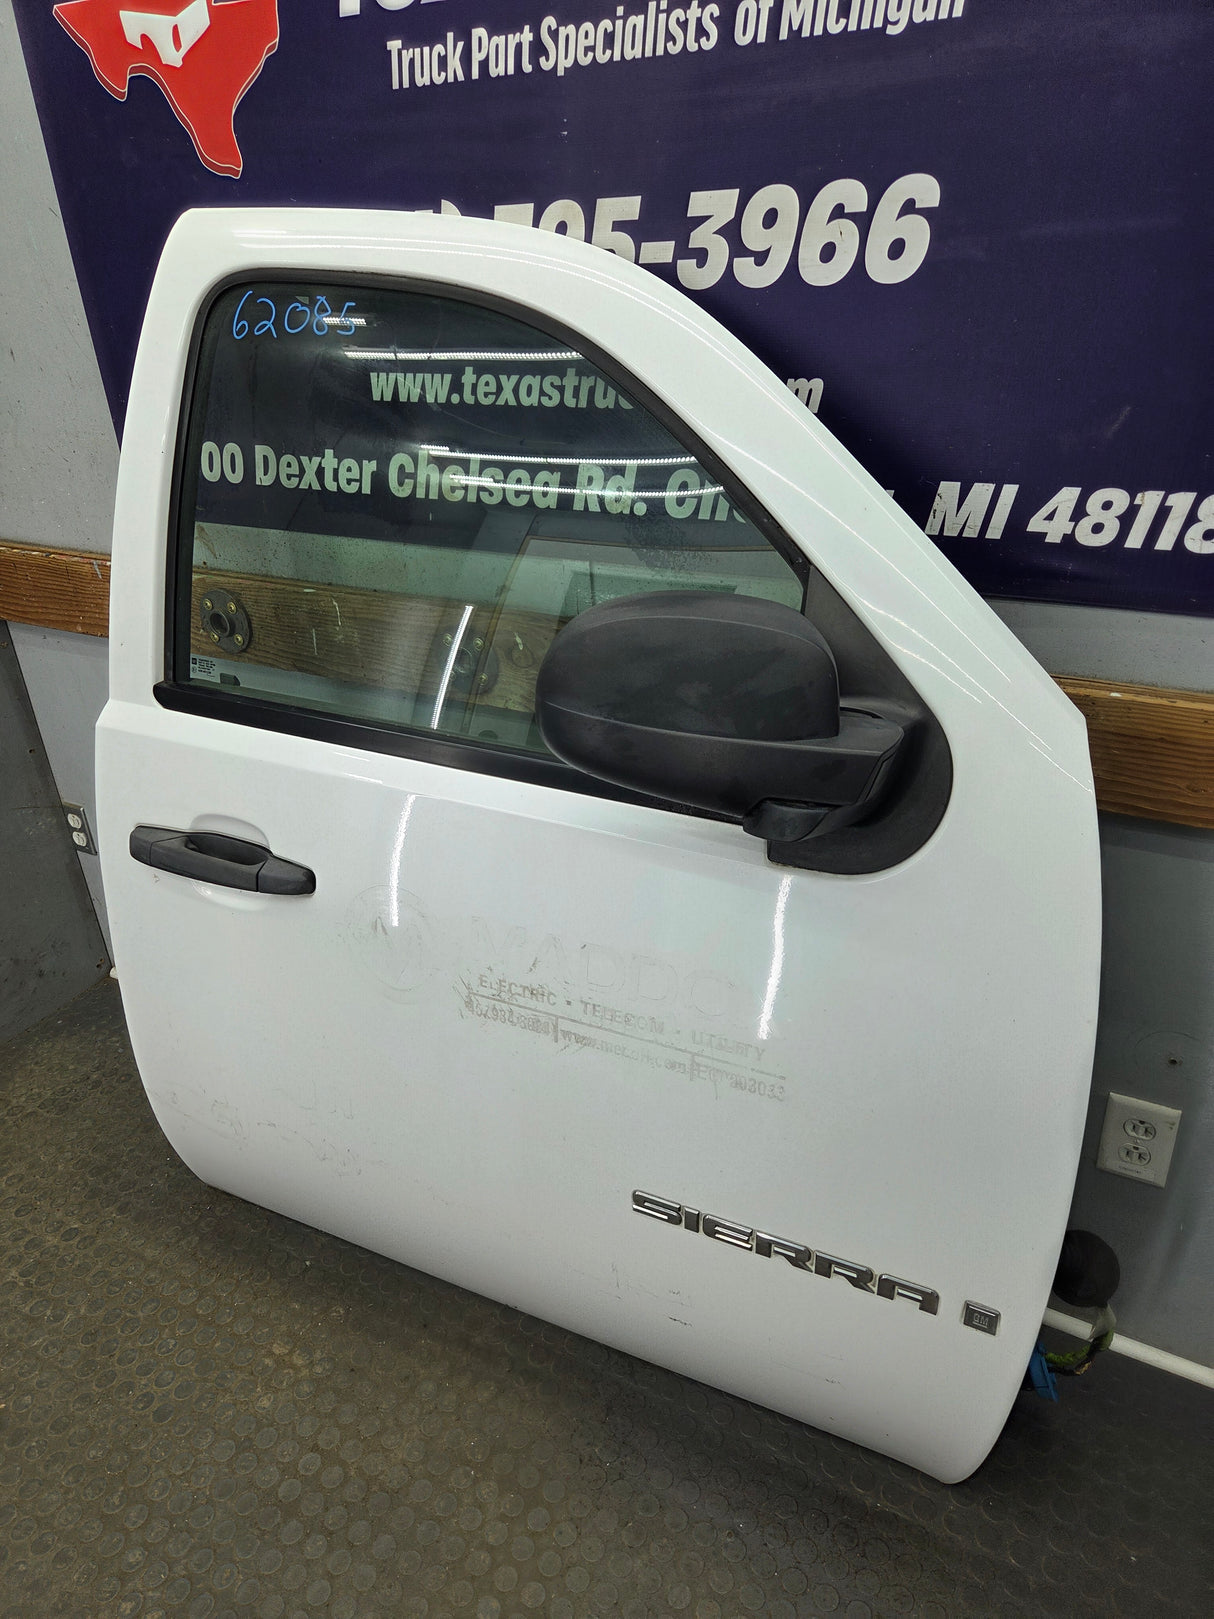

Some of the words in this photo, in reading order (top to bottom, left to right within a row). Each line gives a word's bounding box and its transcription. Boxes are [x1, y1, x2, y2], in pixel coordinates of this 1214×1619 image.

[387, 31, 465, 90] Truck
[471, 25, 534, 80] Part
[539, 0, 720, 77] Specialists
[734, 0, 774, 46] of
[779, 0, 966, 41] Michigan
[494, 173, 941, 289] 5-3966
[233, 291, 357, 340] 62085
[254, 444, 377, 495] Dexter
[388, 449, 562, 510] Chelsea
[574, 461, 648, 517] Rd.
[924, 481, 1019, 539] MI
[1026, 486, 1214, 554] 48118
[632, 1189, 940, 1316] SIERRA
